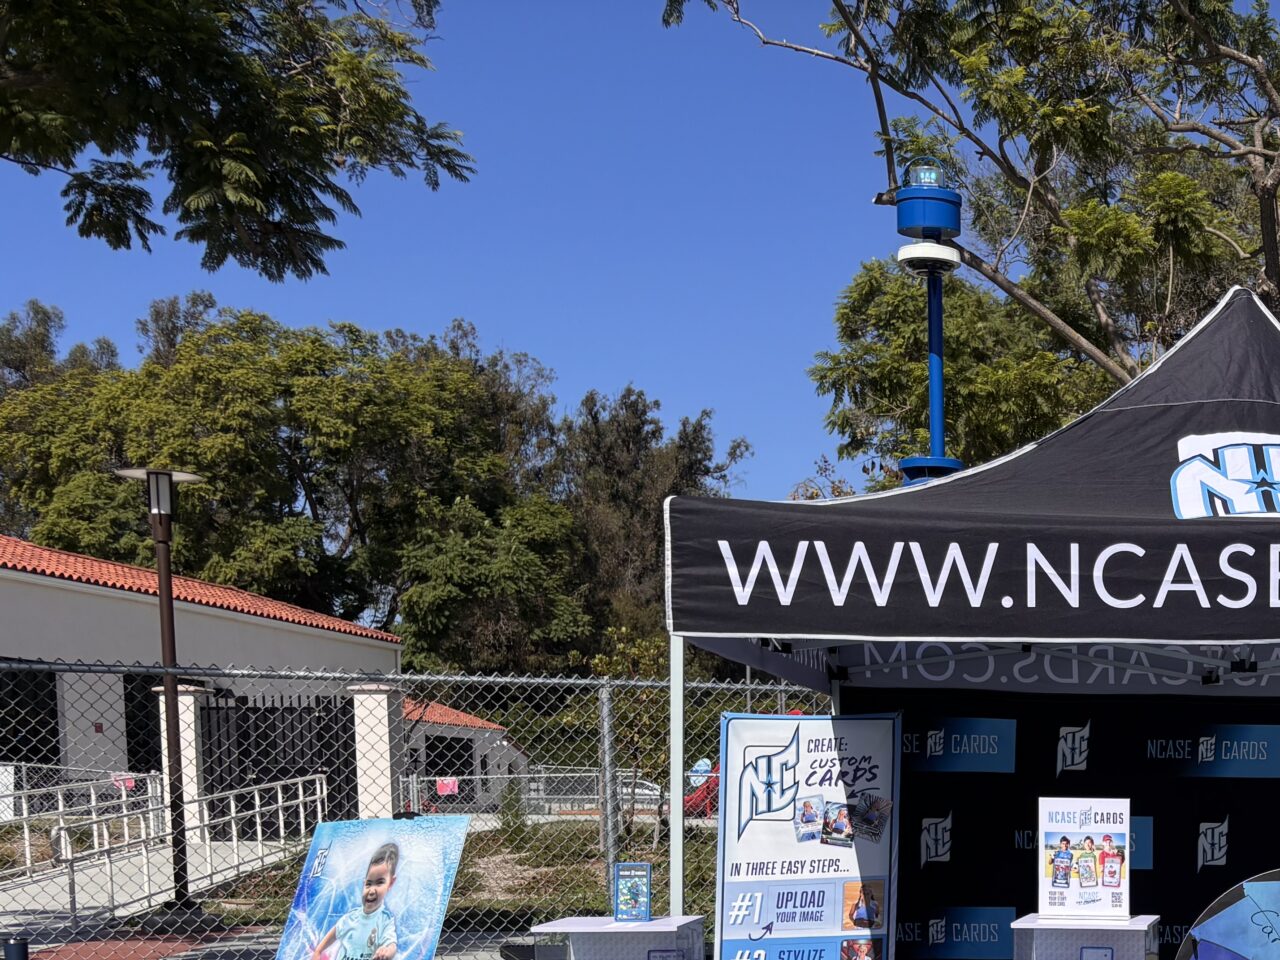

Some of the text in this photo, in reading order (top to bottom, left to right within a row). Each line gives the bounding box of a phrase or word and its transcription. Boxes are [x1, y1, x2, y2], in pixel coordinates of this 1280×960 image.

[806, 737, 849, 754] CREATE:
[951, 734, 998, 755] CARDS
[1147, 739, 1192, 759] NCASE
[1221, 741, 1268, 761] CARDS
[810, 755, 872, 770] CUSTOM
[805, 765, 880, 787] CARDS
[1048, 811, 1077, 824] NCASE
[1094, 812, 1124, 825] CARDS
[730, 859, 850, 877] IN THREE EASY STEPS...
[728, 892, 764, 925] #1
[776, 890, 826, 909] UPLOAD
[776, 911, 825, 923] YOUR IMAGE
[896, 922, 922, 942] ASE
[952, 923, 999, 942] CARDS
[1158, 925, 1188, 944] CASE
